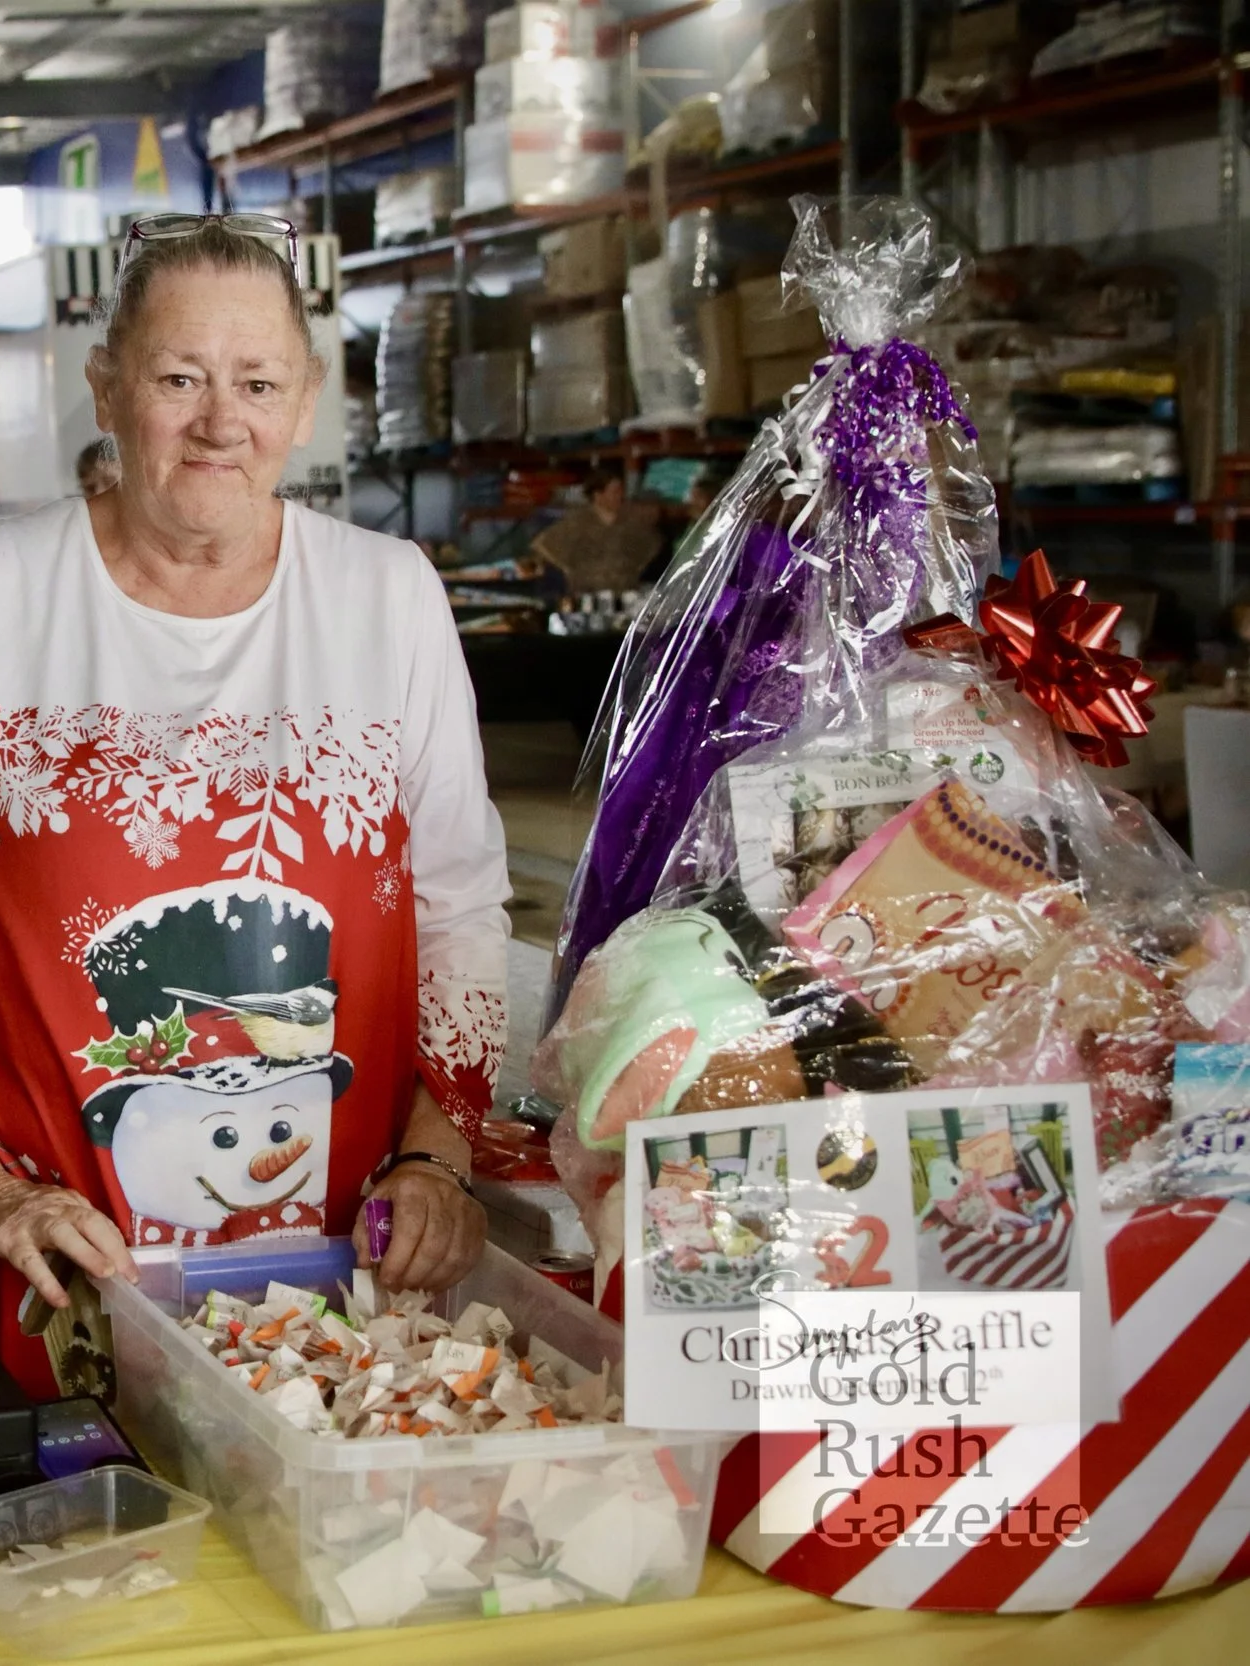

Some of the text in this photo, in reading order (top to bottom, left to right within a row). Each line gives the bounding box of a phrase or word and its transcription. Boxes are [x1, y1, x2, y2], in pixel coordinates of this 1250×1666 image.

[834, 776, 871, 792] BON
[876, 770, 913, 788] BON
[916, 1308, 1053, 1354] Raffle
[731, 1376, 812, 1401] Drawn
